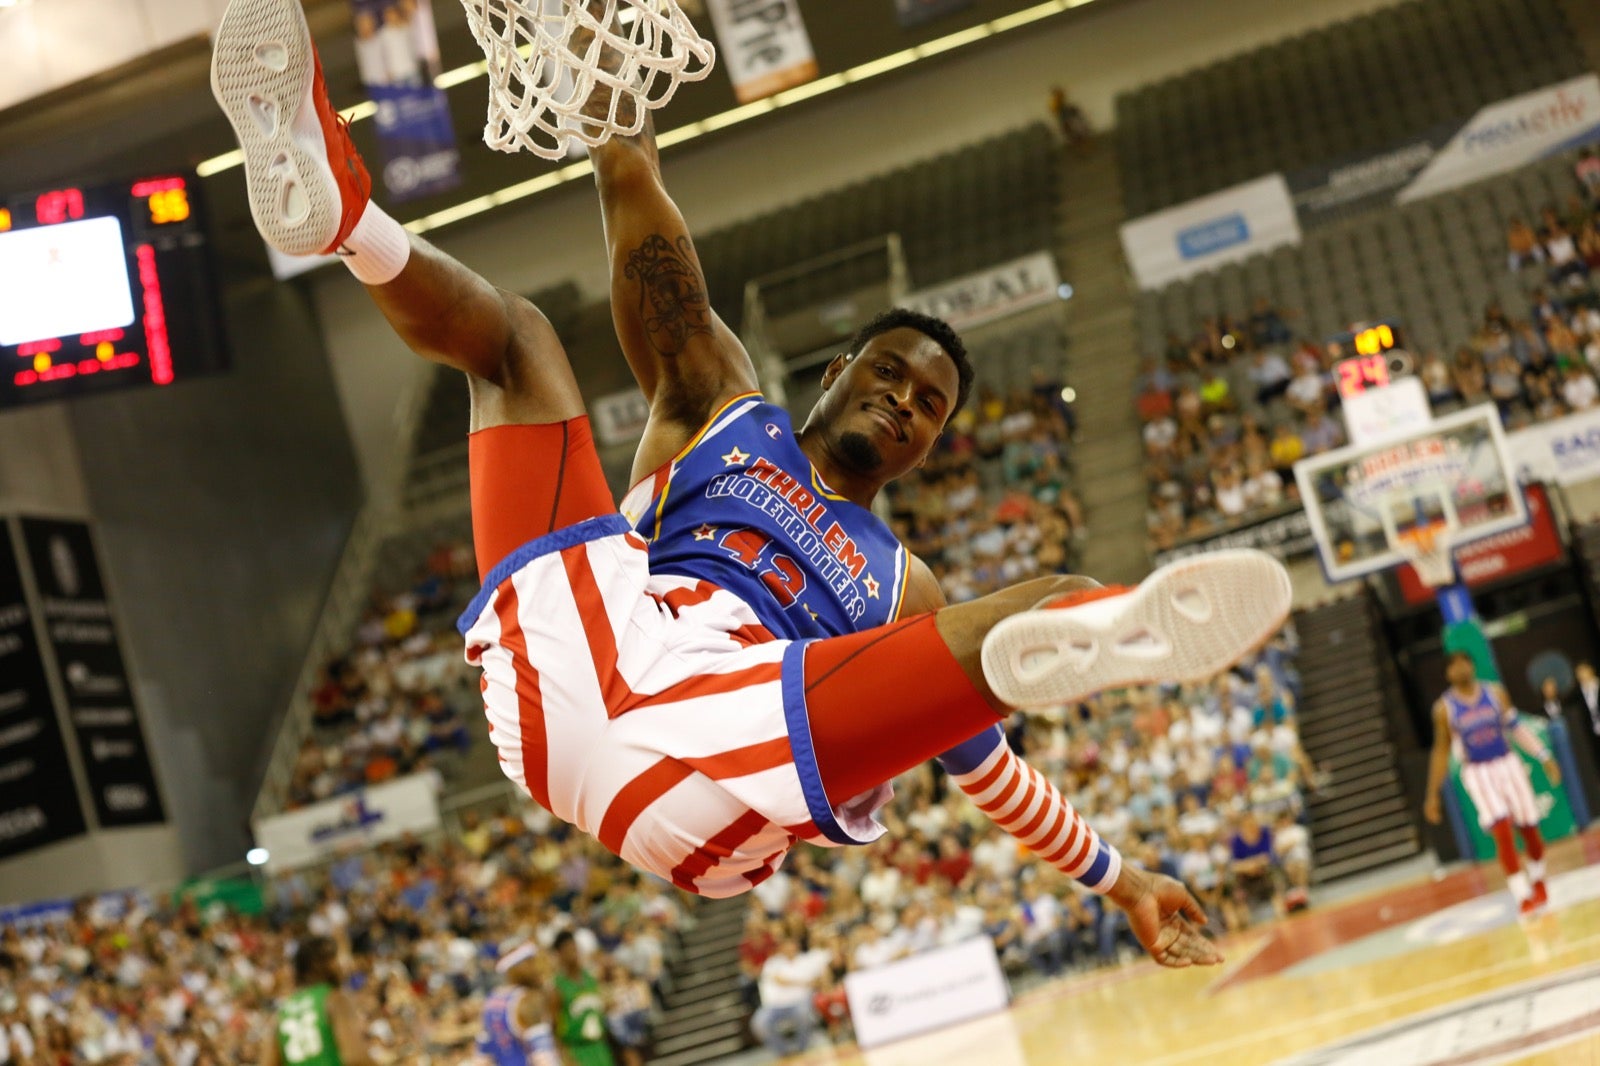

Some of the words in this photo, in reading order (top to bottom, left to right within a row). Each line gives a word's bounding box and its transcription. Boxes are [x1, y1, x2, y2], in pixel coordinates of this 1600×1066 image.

[706, 474, 866, 622] GLOBETROTTERS
[718, 526, 807, 611] 42
[744, 456, 868, 581] HARLEM
